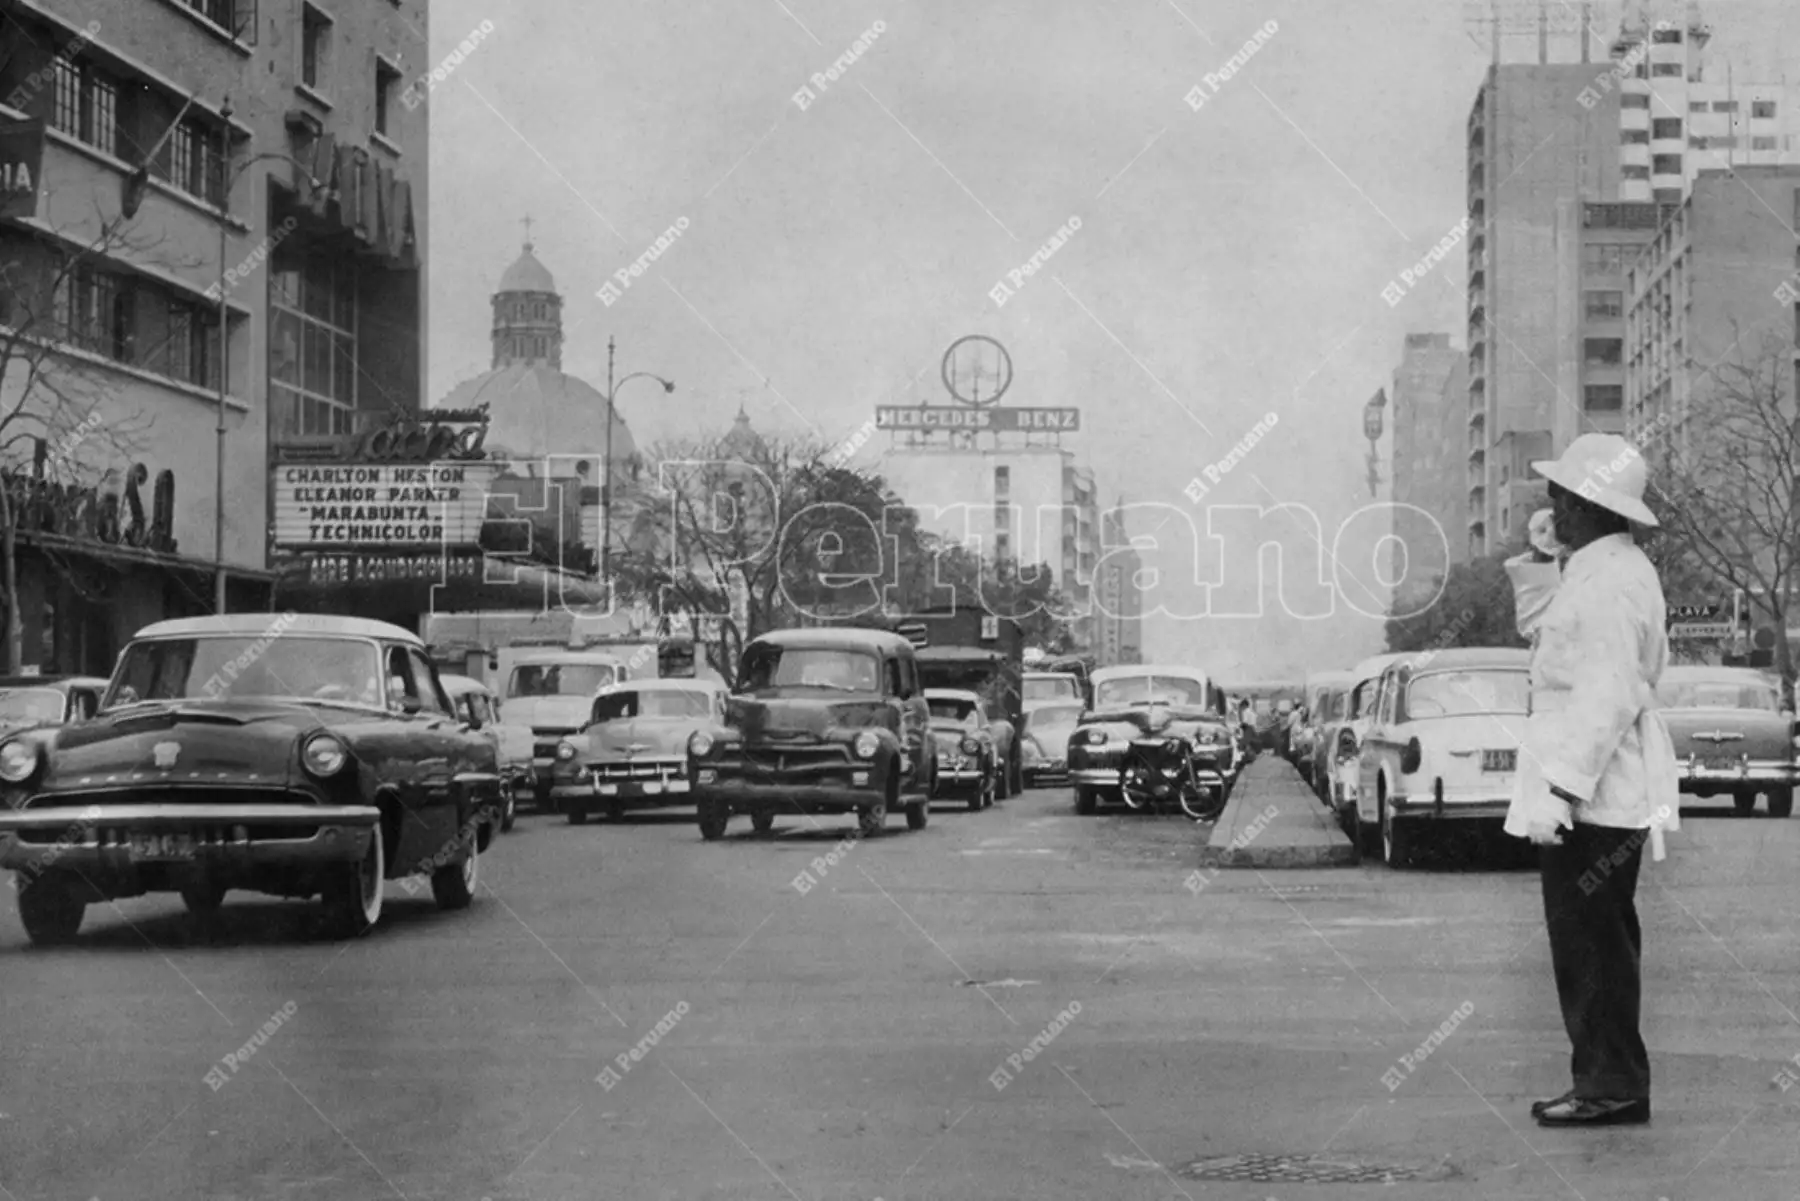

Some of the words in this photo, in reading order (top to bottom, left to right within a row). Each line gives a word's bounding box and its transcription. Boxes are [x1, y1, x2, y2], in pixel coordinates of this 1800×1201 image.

[0, 162, 33, 192] IA
[879, 410, 991, 428] MERCEDES
[1016, 410, 1075, 428] BENZ
[285, 468, 380, 483] CHARLTON
[394, 468, 465, 483] HESTON
[294, 487, 376, 502] ELEANOR
[309, 525, 443, 540] TECHNICOLOR
